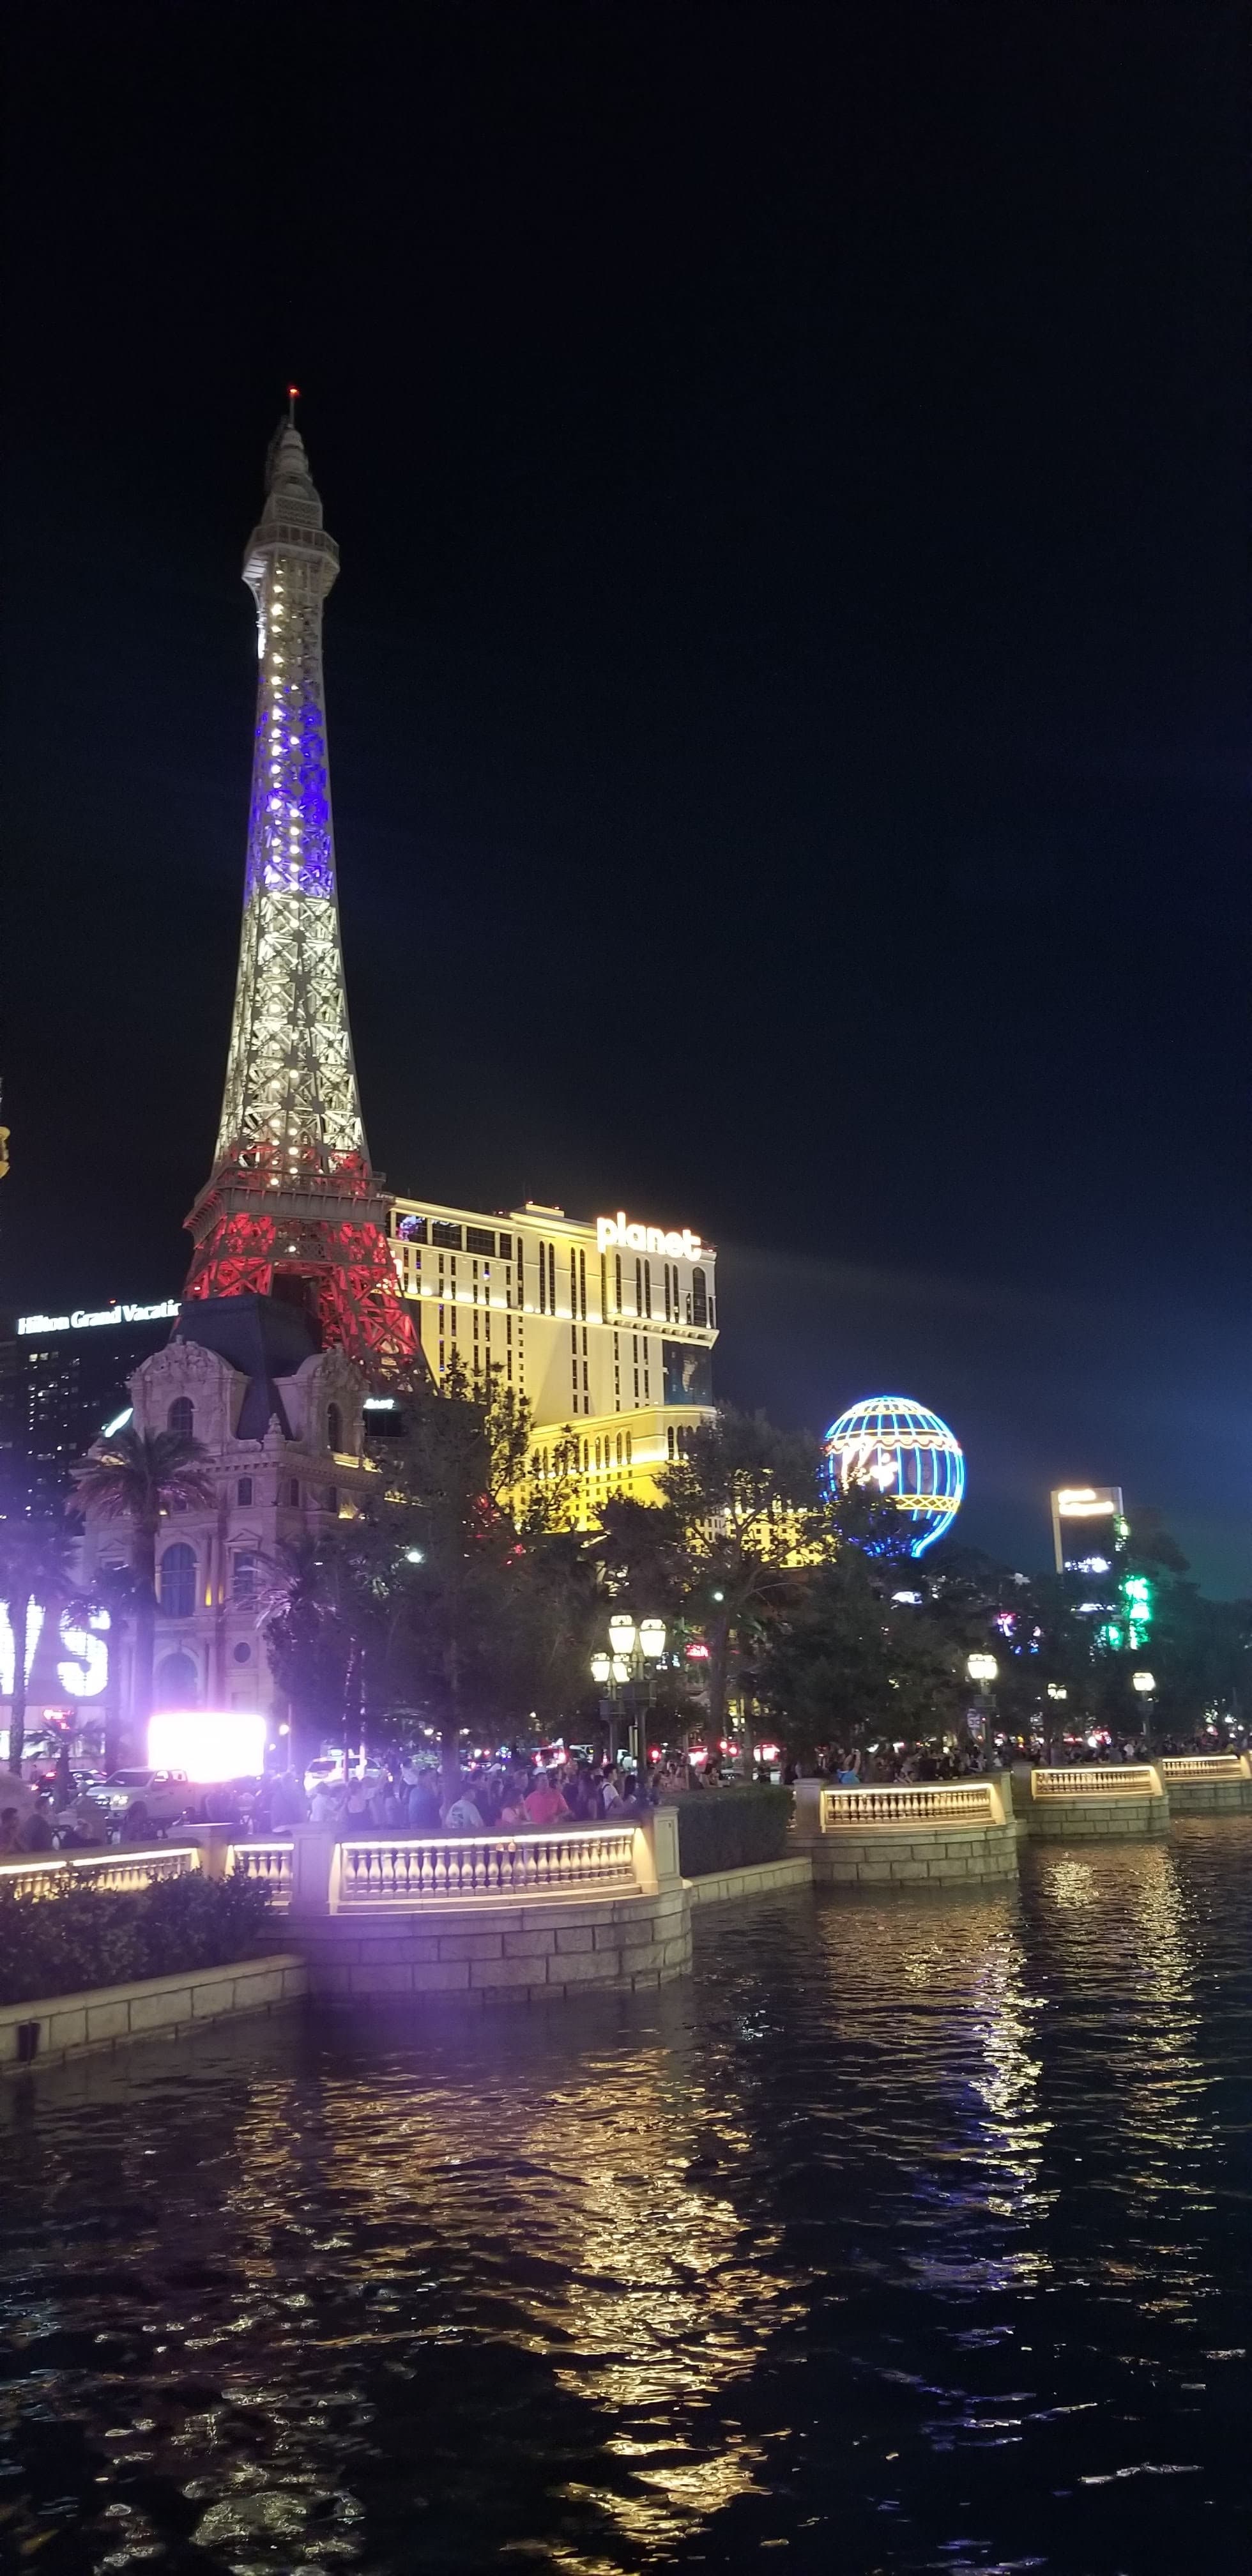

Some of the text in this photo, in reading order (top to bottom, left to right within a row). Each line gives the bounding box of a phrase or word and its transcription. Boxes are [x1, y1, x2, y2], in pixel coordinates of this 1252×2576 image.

[597, 1211, 701, 1262] planet
[17, 1315, 70, 1335] Hilton
[70, 1305, 121, 1328] Grand
